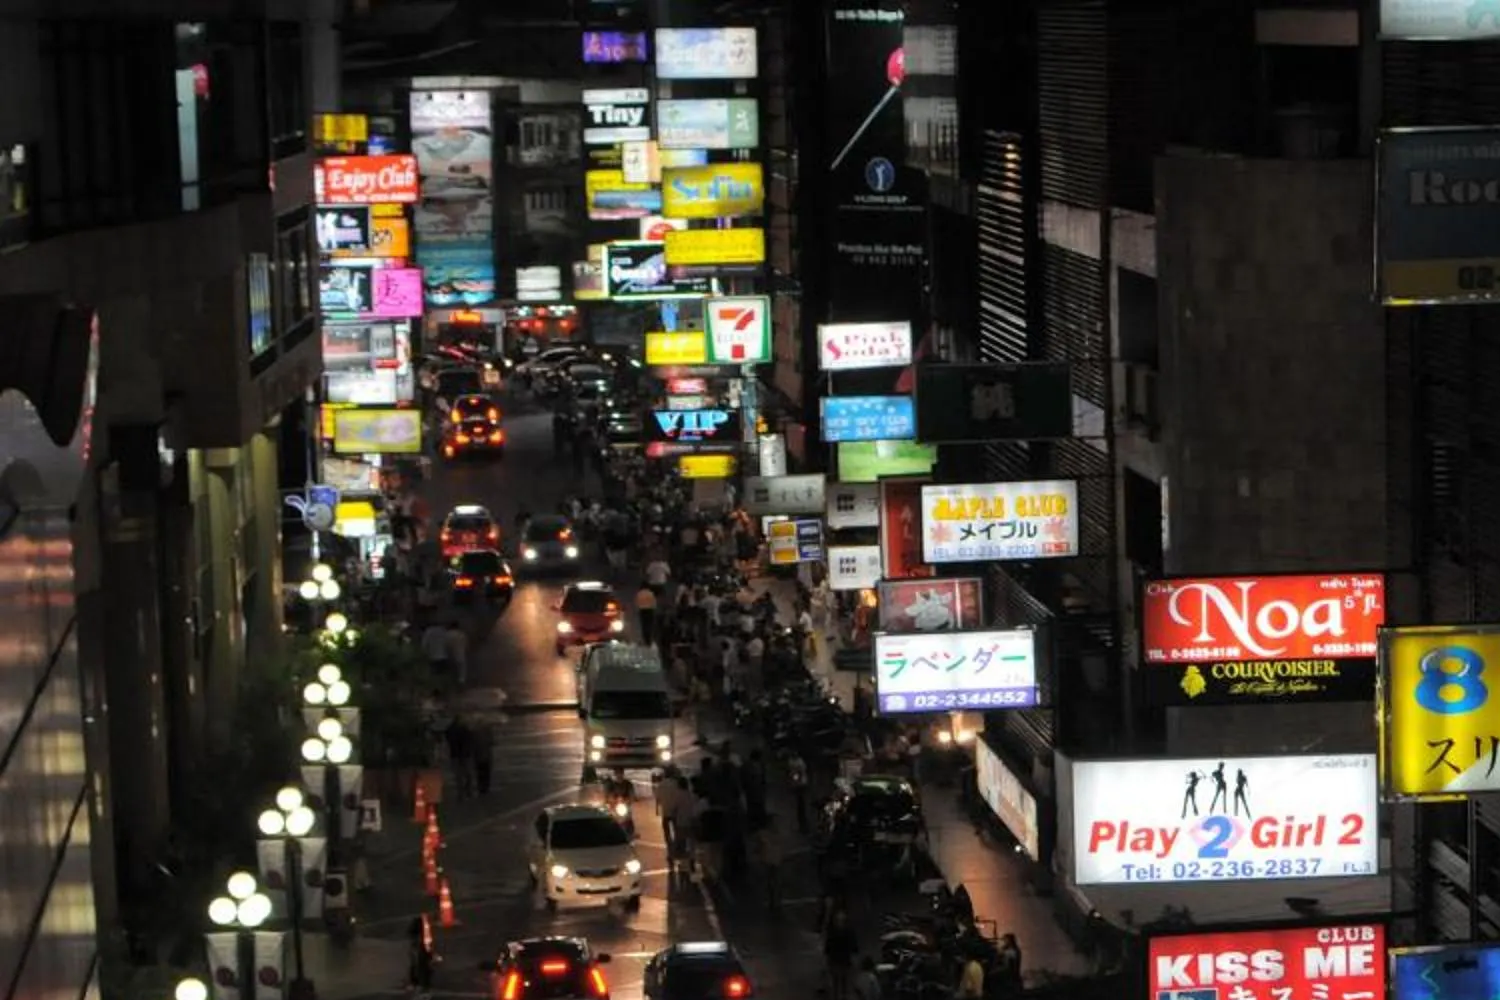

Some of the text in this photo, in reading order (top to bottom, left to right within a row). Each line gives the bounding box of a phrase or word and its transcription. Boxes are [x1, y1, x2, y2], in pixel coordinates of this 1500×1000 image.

[588, 105, 644, 126] Tiny
[379, 166, 415, 189] Club
[655, 410, 729, 433] VIP
[1168, 580, 1347, 657] Noa
[883, 643, 1027, 679] ラベンダー
[1212, 661, 1338, 682] COURVOISIER
[1087, 813, 1364, 859] Play 2 Girl 2
[1121, 863, 1161, 881] Tel:
[1173, 858, 1322, 879] 02-236-2837
[1317, 926, 1376, 943] CLUB
[1156, 944, 1375, 988] KISS ME
